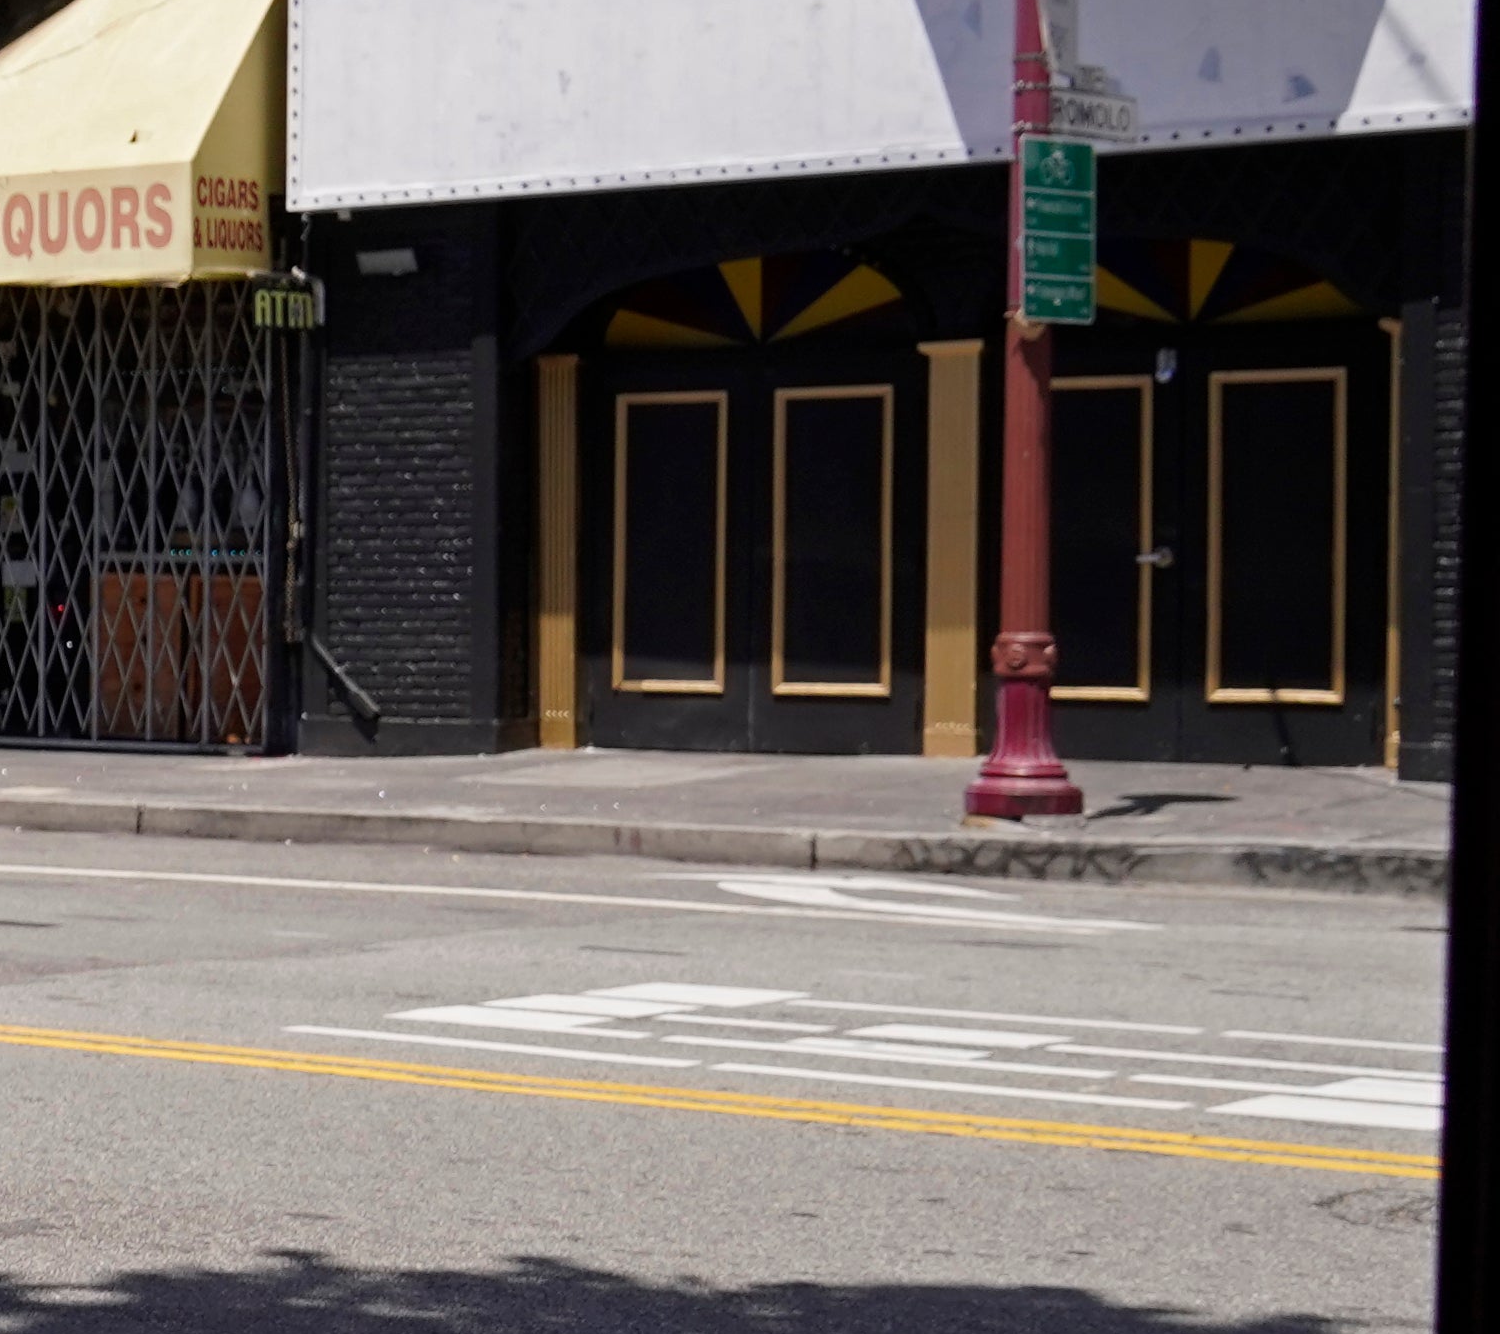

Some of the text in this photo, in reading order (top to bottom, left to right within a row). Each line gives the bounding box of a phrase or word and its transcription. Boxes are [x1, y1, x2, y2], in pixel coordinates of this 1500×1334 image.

[1051, 97, 1131, 132] ROMOLO
[196, 175, 259, 212] CIGARS
[193, 216, 264, 252] & LIQUORS
[255, 288, 314, 329] ATM
